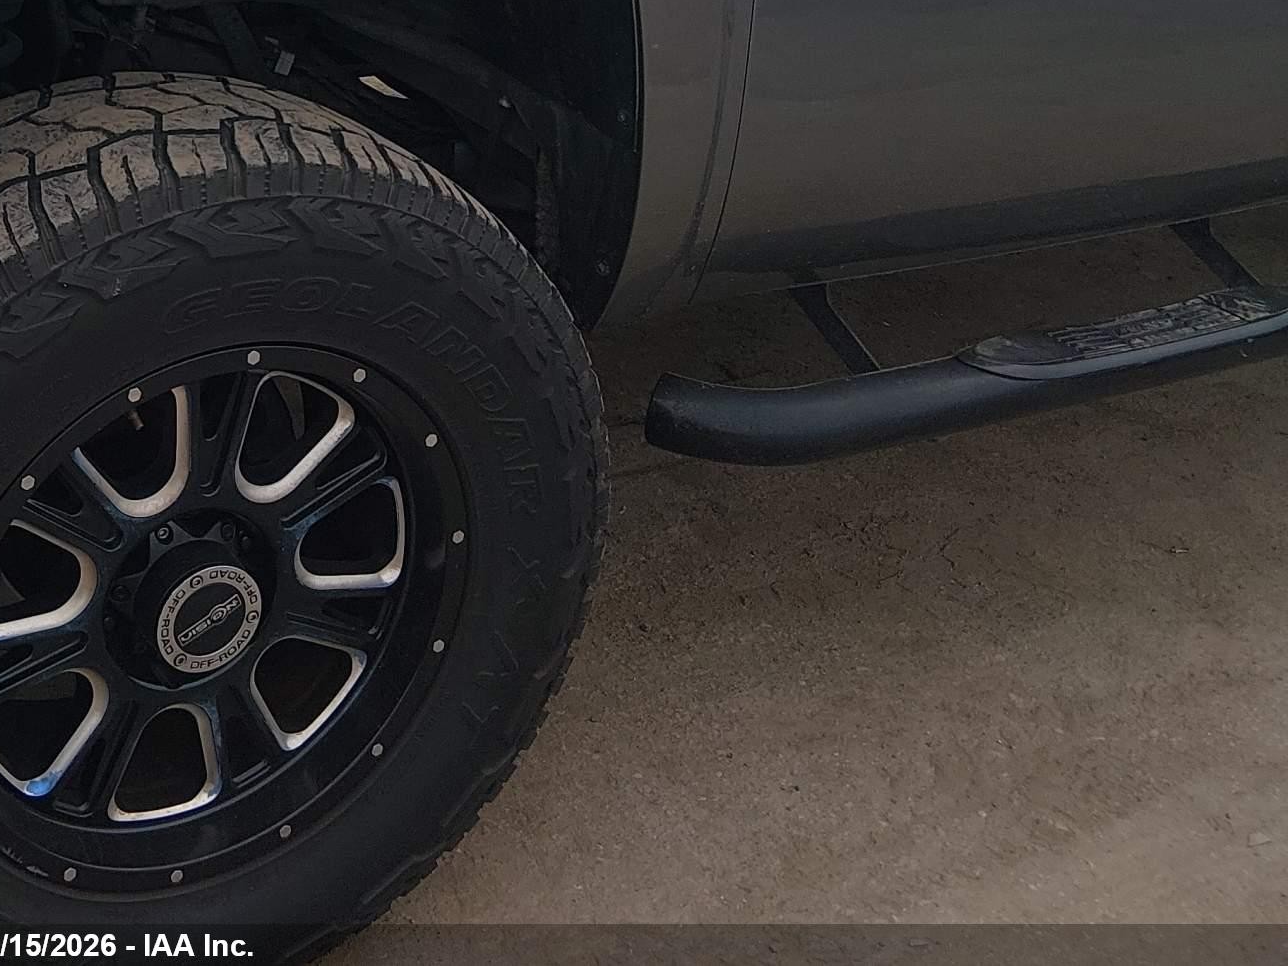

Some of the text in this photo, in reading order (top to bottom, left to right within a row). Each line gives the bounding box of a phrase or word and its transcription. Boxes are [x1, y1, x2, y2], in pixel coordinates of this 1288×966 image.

[162, 275, 545, 517] GEOLANDAR
[209, 569, 258, 604] OFF-ROAD
[161, 589, 186, 655] OFF-ROAD
[190, 629, 251, 669] OFF-ROAD
